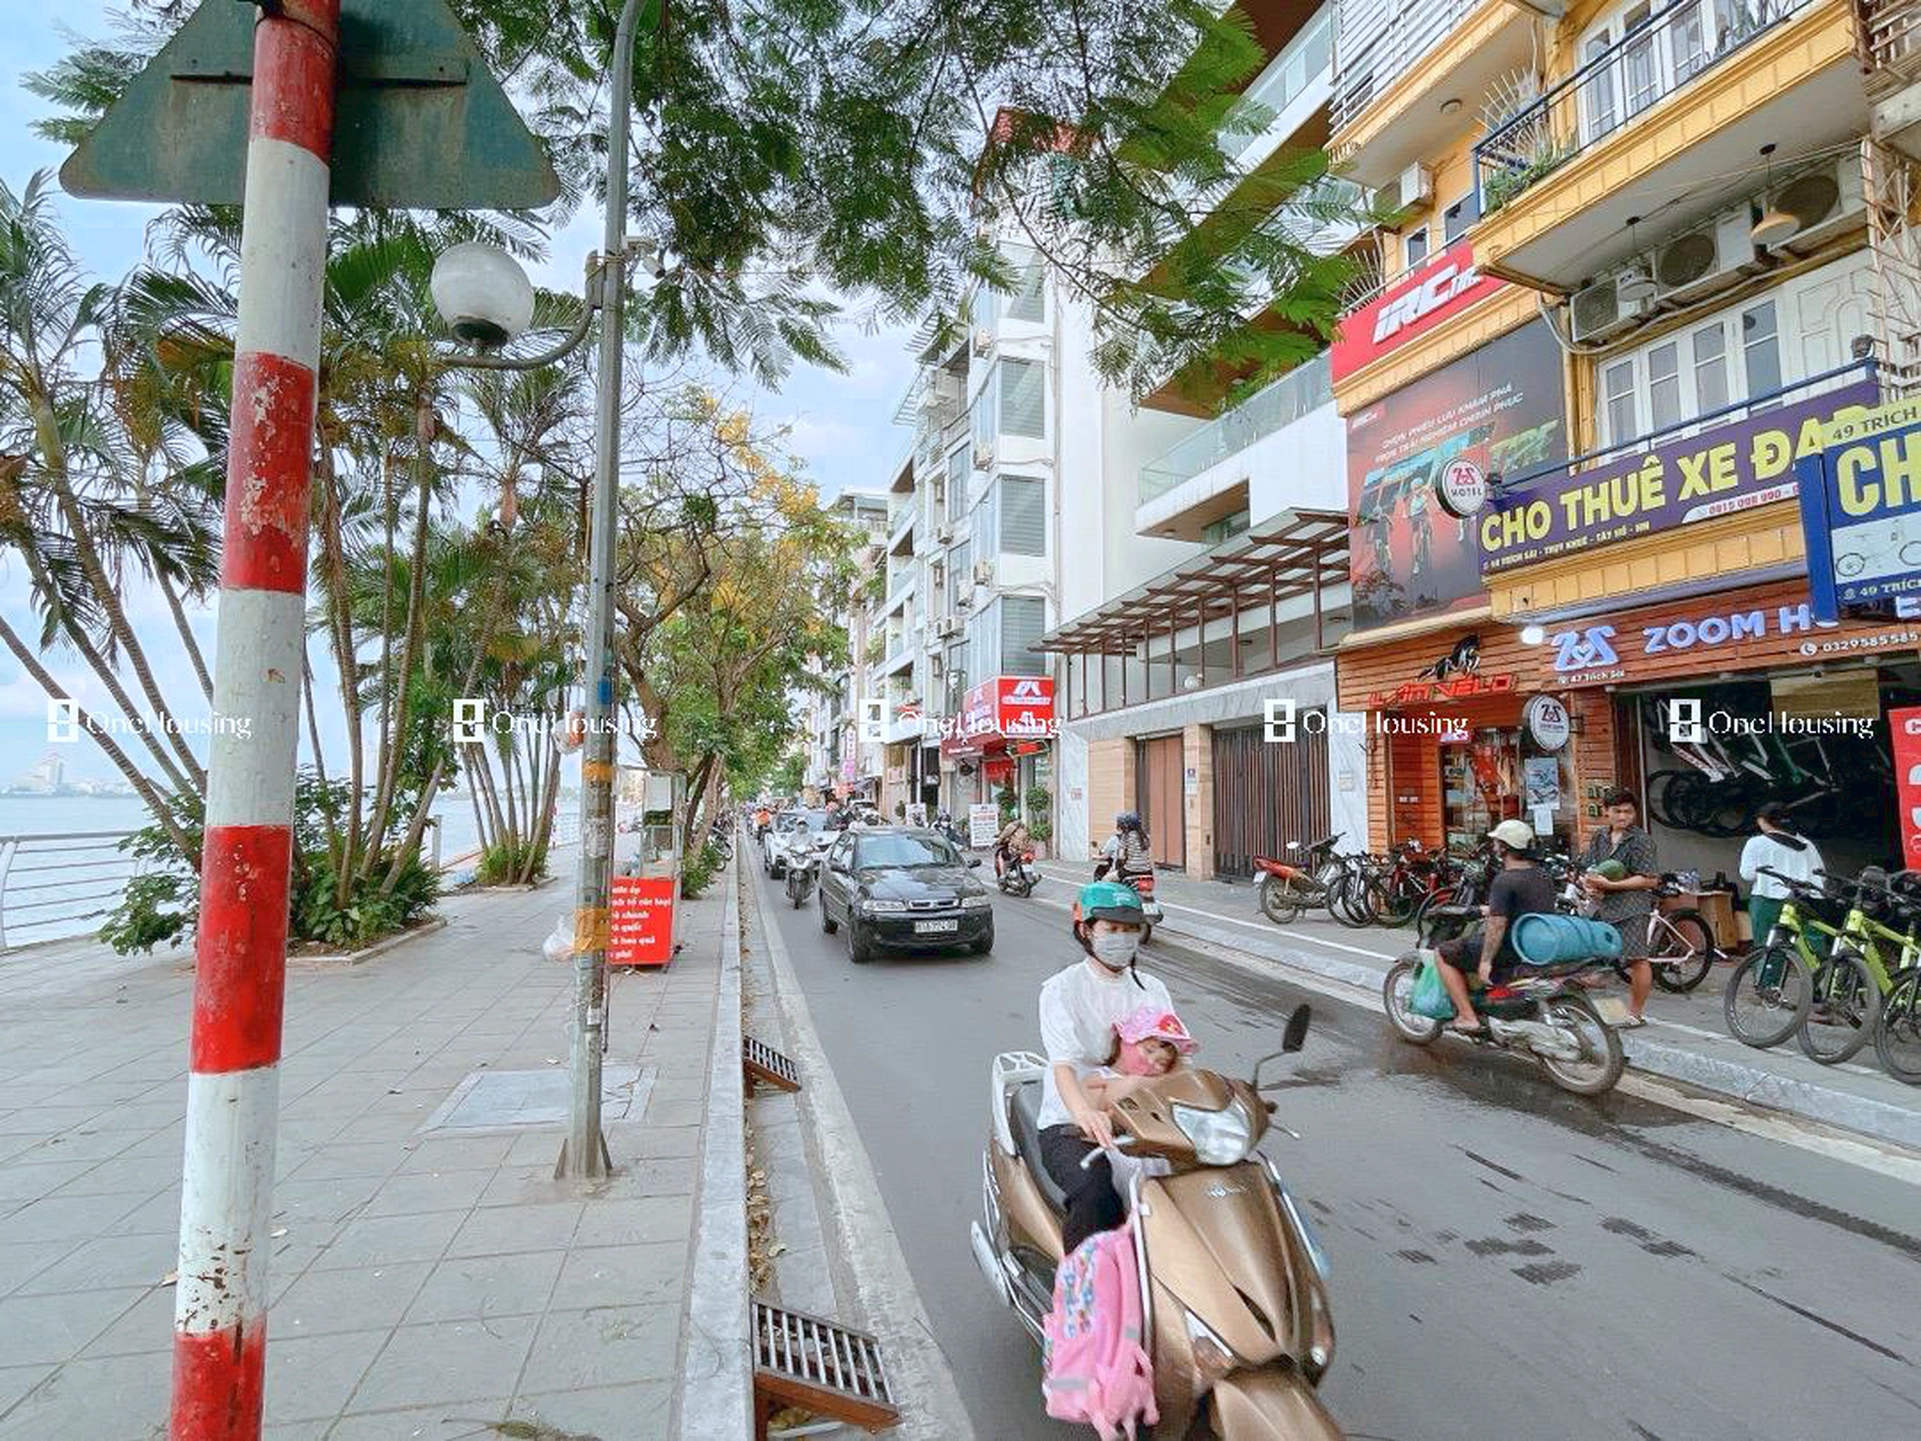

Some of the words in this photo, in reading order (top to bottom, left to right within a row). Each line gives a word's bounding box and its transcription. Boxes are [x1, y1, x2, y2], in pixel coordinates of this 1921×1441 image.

[1833, 424, 1855, 440] 49
[1481, 500, 1552, 552] CHO
[1559, 453, 1667, 532] THUÊ
[1677, 443, 1739, 501] XE
[1643, 611, 1766, 654] ZOOM
